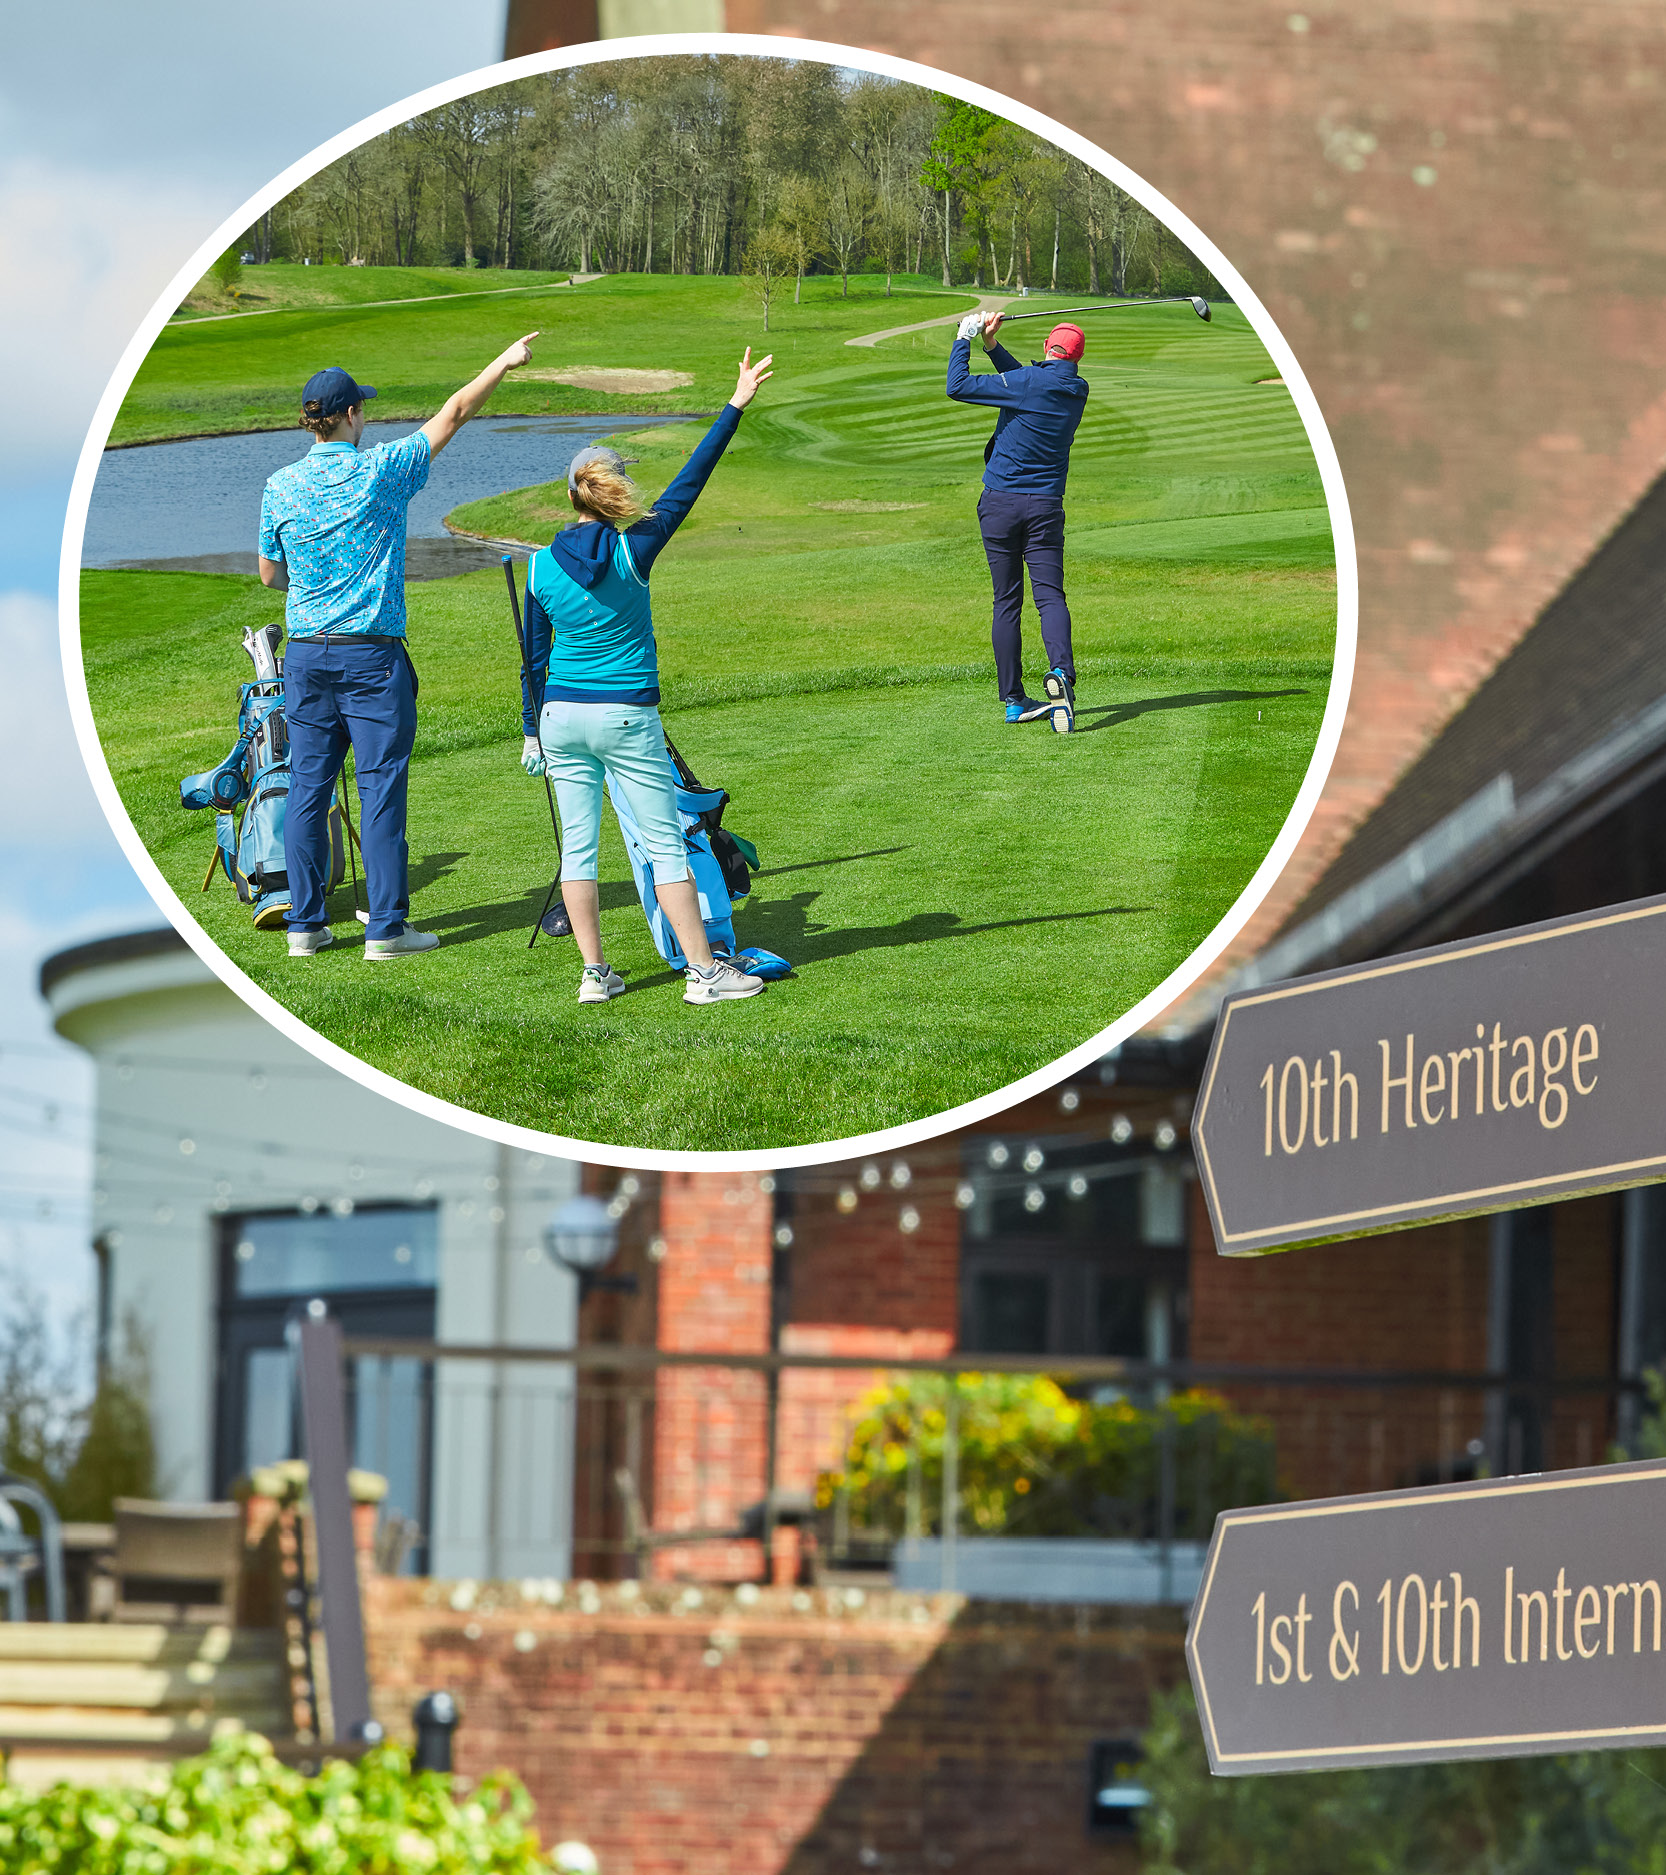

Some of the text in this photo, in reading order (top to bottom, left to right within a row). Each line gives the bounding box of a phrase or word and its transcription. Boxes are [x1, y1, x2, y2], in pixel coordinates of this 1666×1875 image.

[1259, 1022, 1600, 1157] 10th Heritage
[1251, 1592, 1313, 1686] 1st
[1328, 1581, 1361, 1682] &
[1377, 1572, 1482, 1676] 10th
